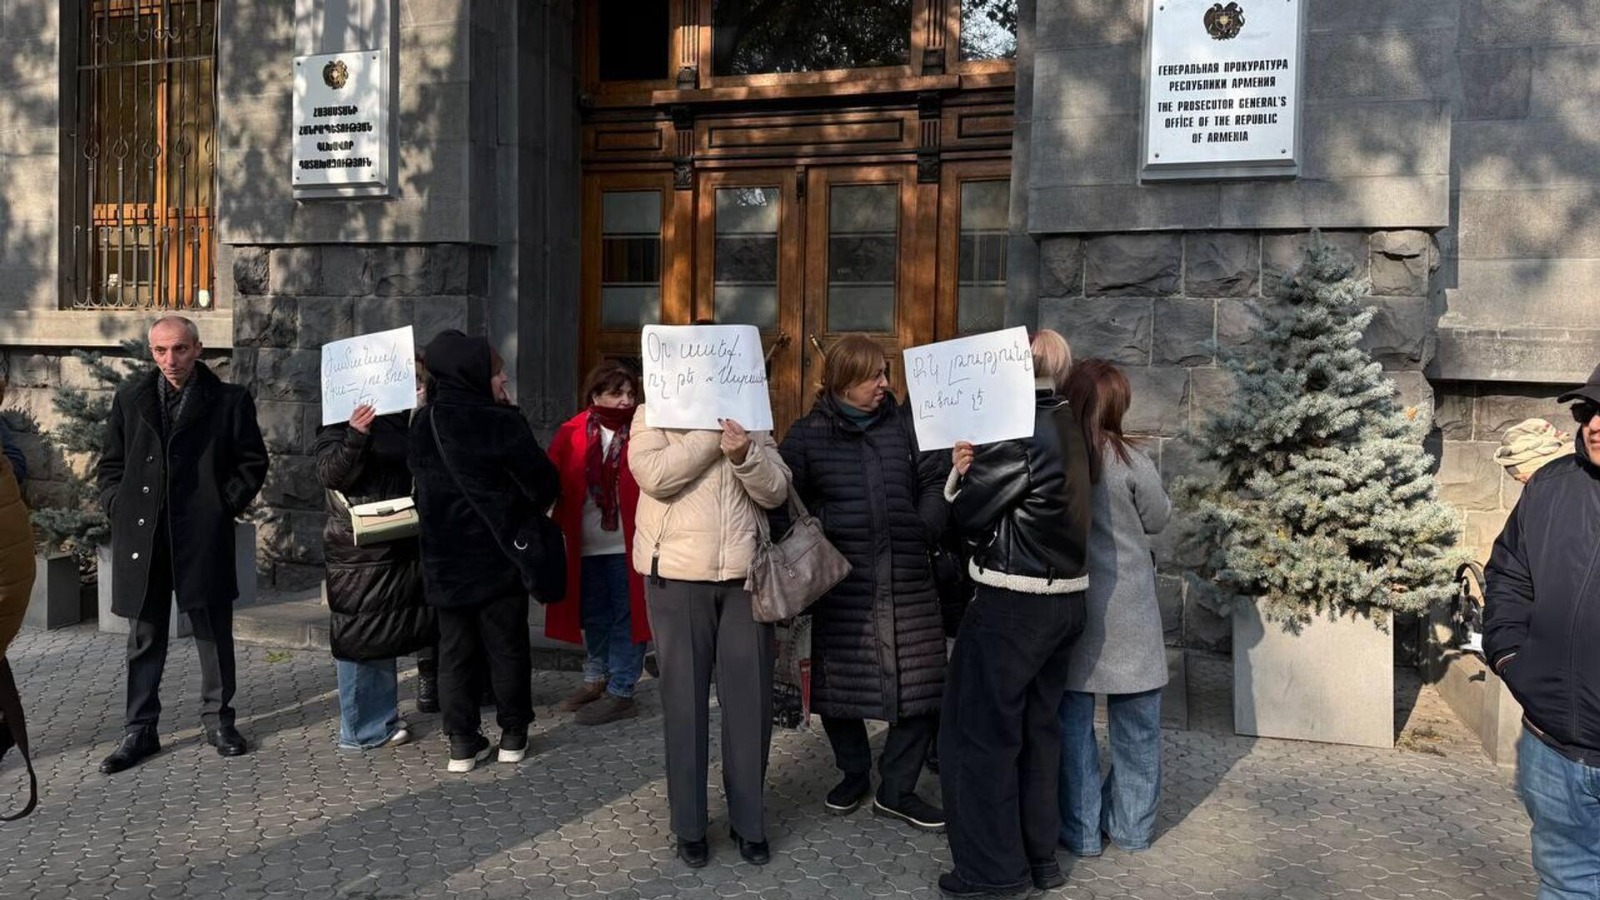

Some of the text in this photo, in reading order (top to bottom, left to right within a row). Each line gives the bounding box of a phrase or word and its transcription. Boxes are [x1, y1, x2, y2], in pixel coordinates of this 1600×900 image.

[1158, 59, 1288, 76] ГЕНЕРАЛЬНАЯ ПРОКУРАТУРА
[1169, 79, 1227, 92] РЕСПУБЛИКИ
[313, 105, 358, 117] ՀԱՅԱՍՏԱՆԻ
[1158, 102, 1173, 113] THE
[1178, 99, 1234, 112] PROSECUTOR
[1199, 116, 1210, 127] OF
[1215, 115, 1230, 126] THE
[1235, 113, 1278, 125] REPUBLIC
[1192, 131, 1249, 143] OF ARMENIA
